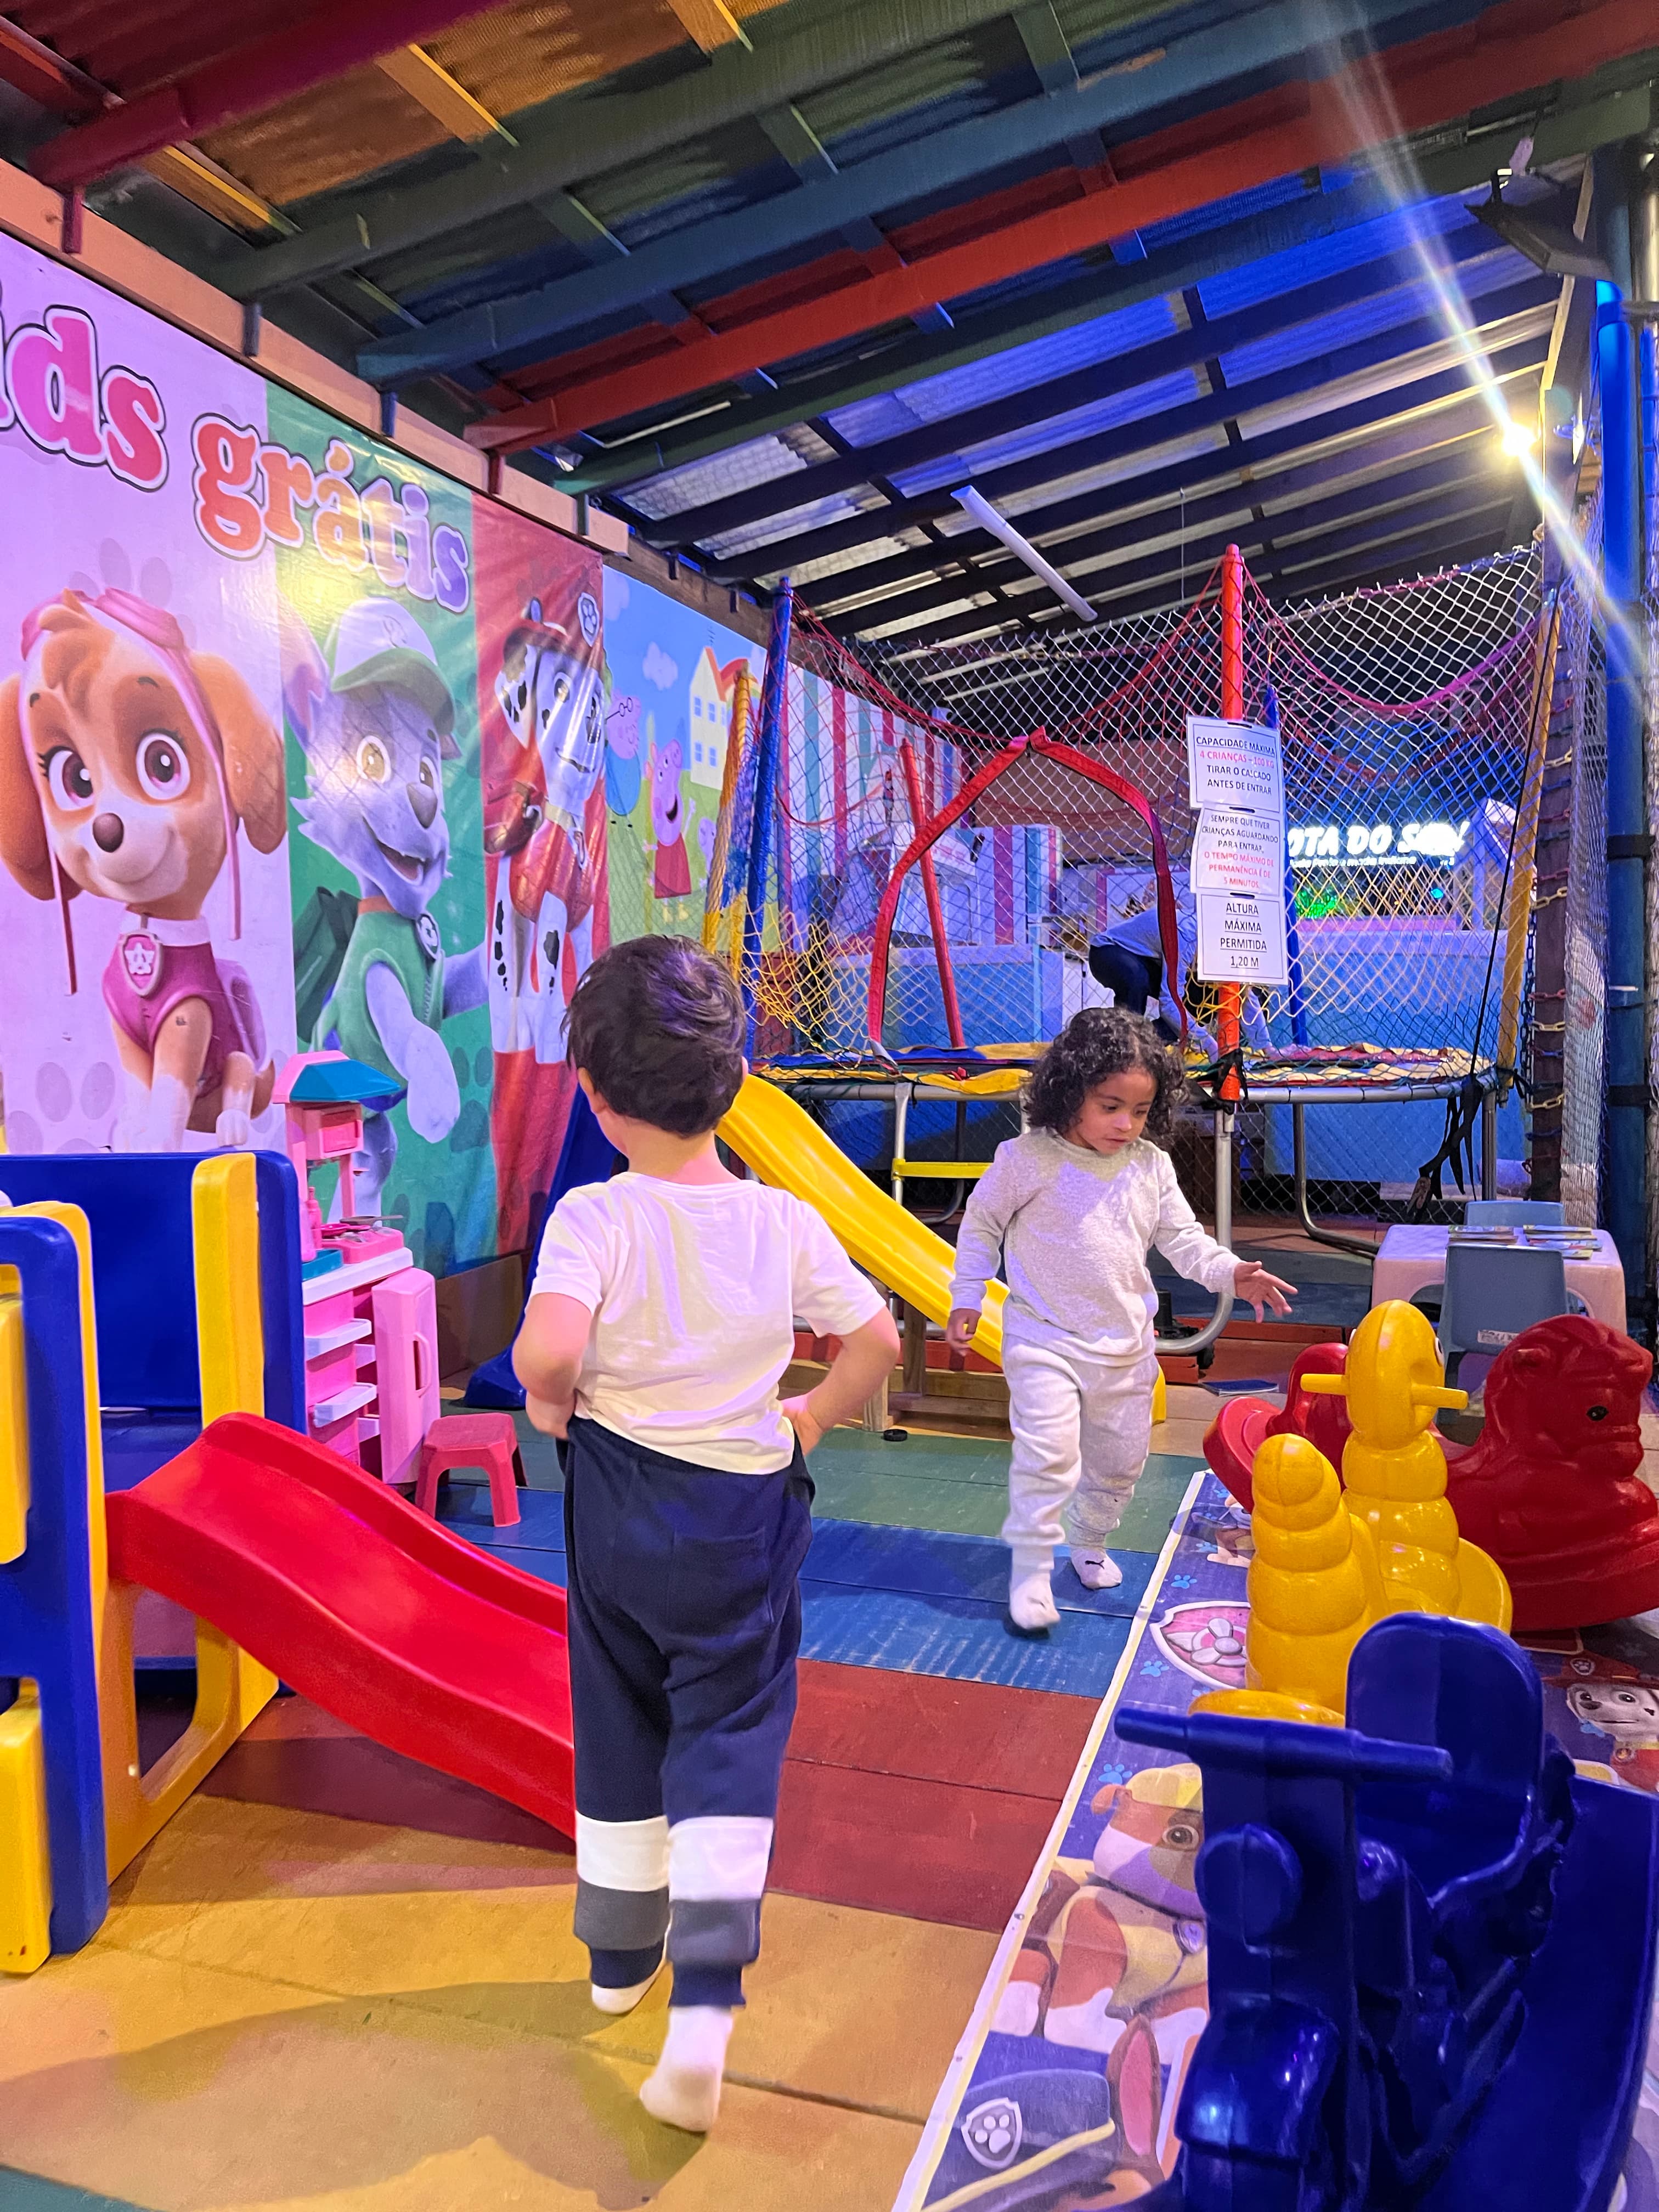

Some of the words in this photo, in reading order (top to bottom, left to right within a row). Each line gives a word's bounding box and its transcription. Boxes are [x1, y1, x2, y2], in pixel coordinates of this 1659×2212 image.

[0, 279, 168, 493] ds
[192, 413, 471, 614] grátis
[1197, 737, 1248, 749] CAPACIDADE
[1249, 741, 1275, 755] MÁXIMA
[1207, 751, 1246, 764] CRIANÇAS
[1254, 757, 1265, 766] 100
[1266, 759, 1274, 768] KG
[1207, 765, 1231, 775] TIRAR
[1234, 767, 1239, 775] O
[1207, 779, 1233, 788] ANTES
[1236, 782, 1245, 790] DE
[1247, 783, 1272, 795] ENTRAR
[1211, 815, 1238, 824] SEMPRE
[1240, 818, 1253, 826] QUE
[1254, 820, 1269, 830] TIVER
[1201, 826, 1234, 837] CRIANÇAS
[1237, 830, 1278, 843] AGUARDANDO
[1346, 825, 1392, 855] DO
[1218, 840, 1238, 849] PARA
[1211, 852, 1238, 860] TEMPO
[1240, 853, 1265, 865] MÁXIMO
[1267, 859, 1274, 867] DE
[1209, 864, 1257, 876] PERMANÊNCIA
[1259, 868, 1262, 877] É
[1226, 903, 1259, 915] ALTURA
[1224, 918, 1262, 932] MÁXIMA
[1220, 938, 1267, 950] PERMITIDA
[1231, 956, 1248, 968] 1,20
[1251, 957, 1259, 967] M
